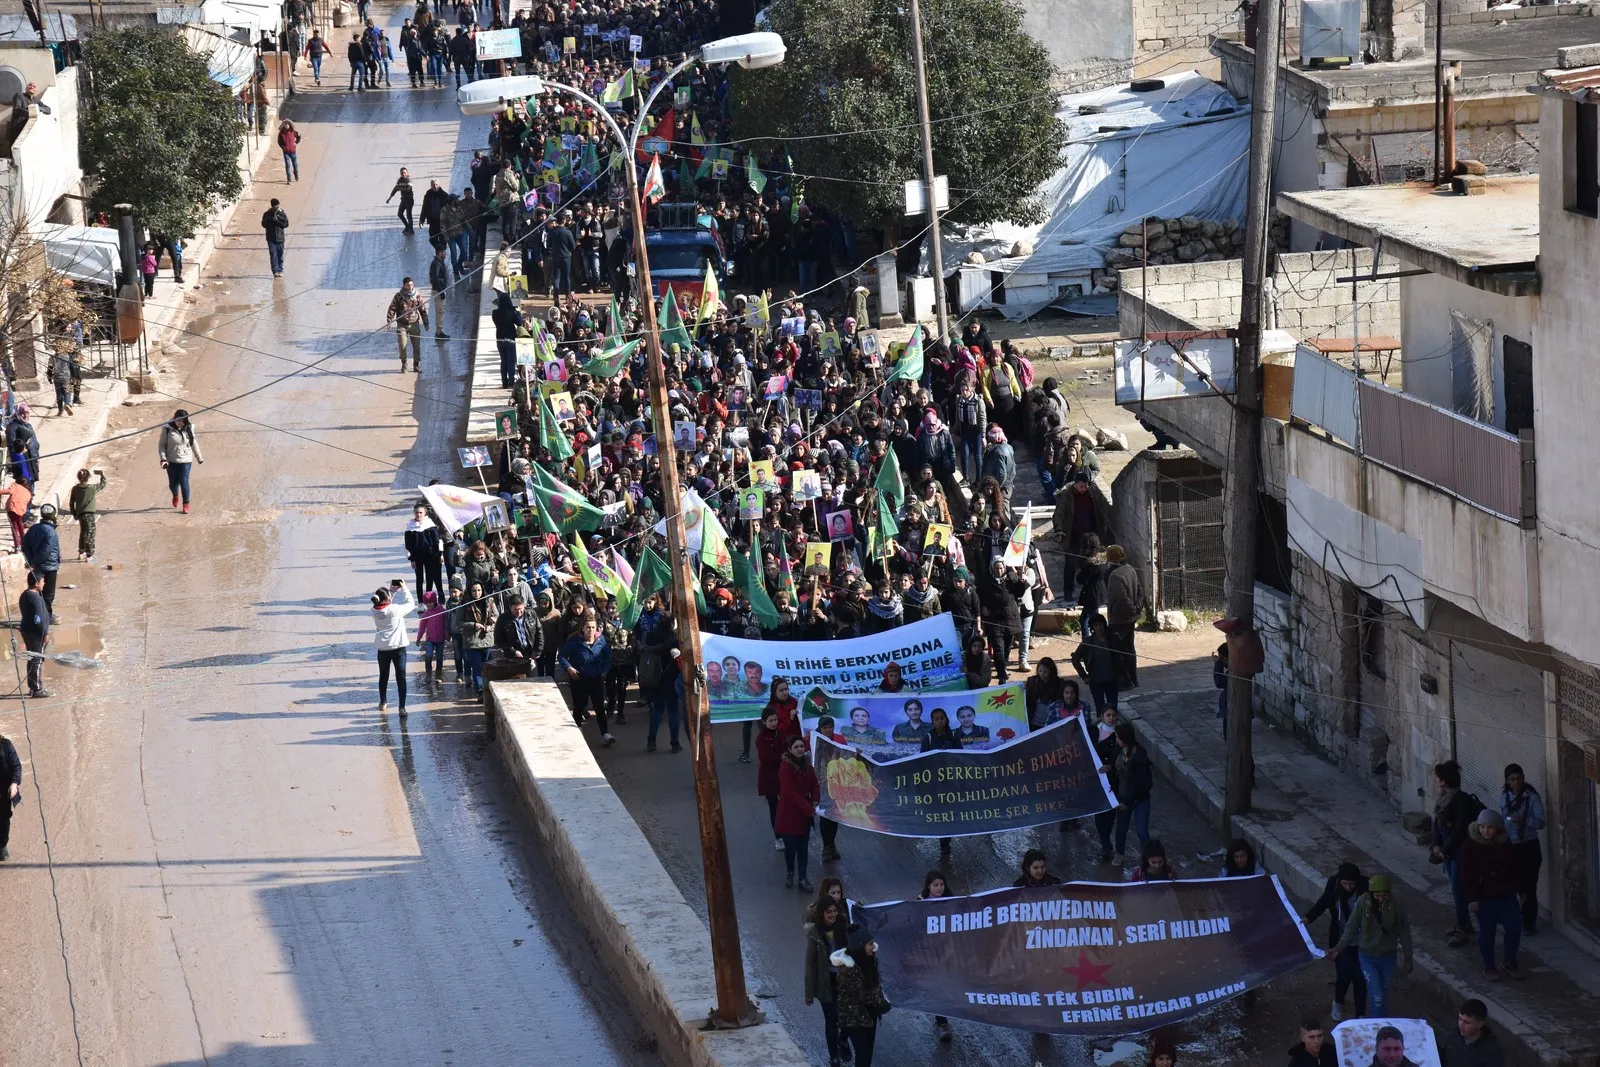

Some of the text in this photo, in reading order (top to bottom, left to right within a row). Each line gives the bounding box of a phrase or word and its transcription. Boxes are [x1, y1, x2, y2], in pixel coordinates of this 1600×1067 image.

[835, 638, 944, 668] BERXWEDANA
[840, 671, 851, 683] Û
[921, 651, 955, 671] EMÊ
[894, 775, 907, 790] JI
[913, 770, 932, 785] BO
[897, 795, 909, 807] JI
[914, 794, 933, 805] BO
[938, 784, 1030, 805] TOLHILDANA
[960, 809, 1001, 821] HILDE
[1006, 804, 1030, 820] ŞER
[926, 899, 1117, 935] BI RIHÊ BERXWEDANA
[1126, 919, 1167, 945] SERÎ
[1171, 917, 1231, 940] HILDIN
[965, 990, 1041, 1007] TECRÎDÊ
[1044, 988, 1078, 1006] TÊK
[1062, 980, 1247, 1023] EFRÎNÊ RIZGAR BIKIN
